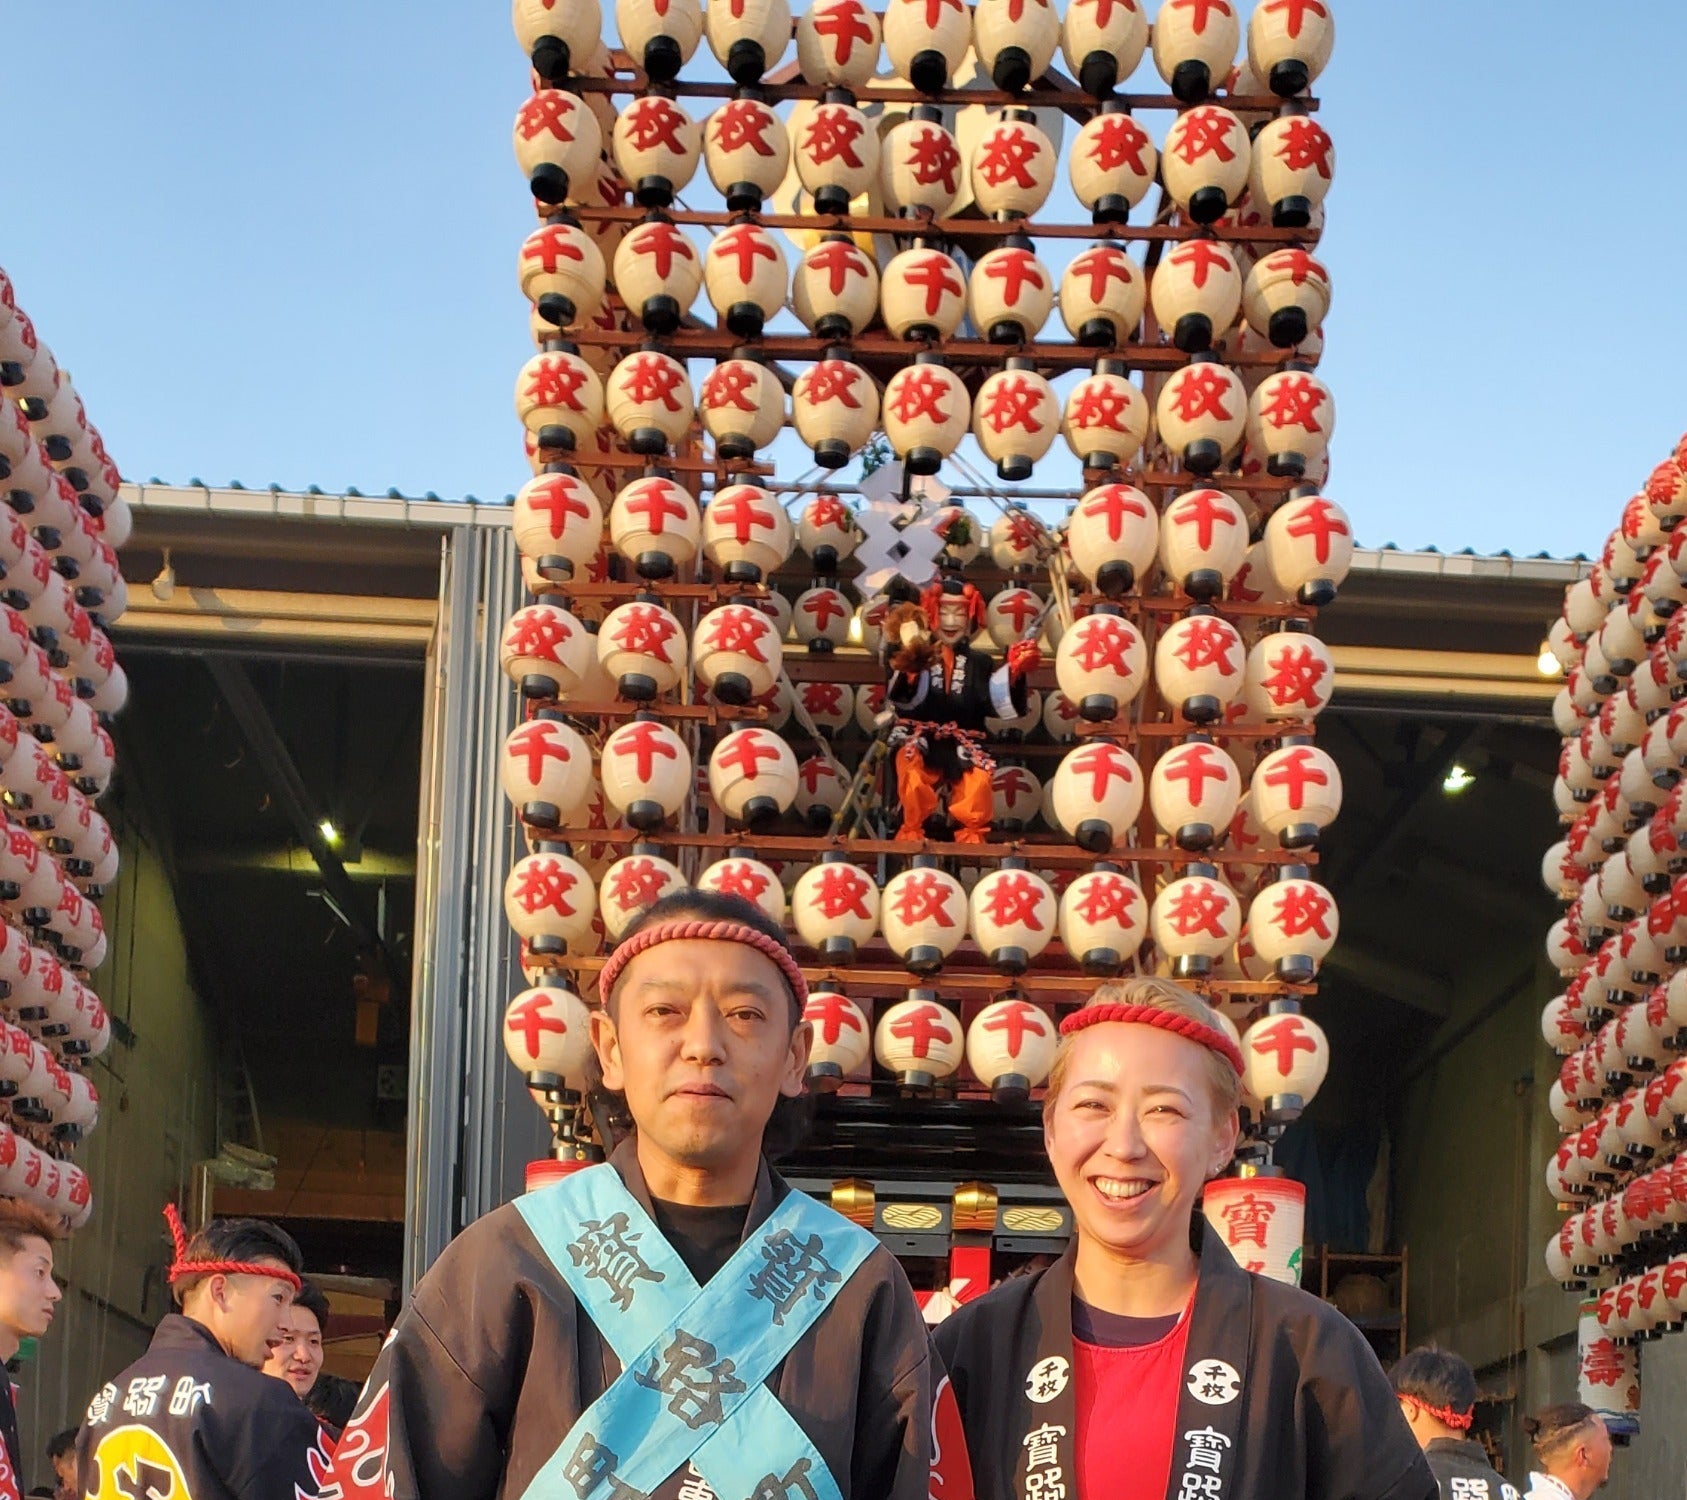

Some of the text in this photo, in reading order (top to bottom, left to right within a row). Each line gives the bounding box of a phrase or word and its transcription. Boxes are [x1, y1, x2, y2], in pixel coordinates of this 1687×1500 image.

[814, 0, 873, 66] 千
[514, 89, 575, 142] 枚
[626, 97, 686, 155] 枚
[712, 100, 774, 156] 枚
[802, 108, 862, 166] 枚
[1175, 105, 1235, 164] 枚
[906, 129, 959, 193] 枚
[979, 128, 1039, 188] 枚
[1088, 117, 1147, 175] 枚
[1277, 116, 1333, 179] 枚
[524, 226, 583, 273] 千
[634, 223, 690, 279] 千
[716, 224, 776, 284] 千
[809, 242, 864, 295] 千
[1074, 248, 1129, 303] 千
[1172, 239, 1230, 288] 千
[1267, 249, 1328, 286] 千
[905, 256, 961, 316] 千
[986, 251, 1043, 307] 千
[524, 359, 587, 412] 枚
[625, 357, 682, 412] 枚
[703, 361, 760, 412] 枚
[803, 360, 863, 409] 枚
[892, 371, 950, 424] 枚
[984, 379, 1043, 433] 枚
[1070, 384, 1131, 433] 枚
[1173, 367, 1231, 422] 枚
[1261, 377, 1325, 432] 枚
[529, 477, 590, 540] 千
[627, 480, 687, 535] 千
[714, 489, 774, 545] 千
[1085, 483, 1146, 542] 千
[1174, 491, 1236, 551] 千
[1288, 500, 1347, 564] 千
[509, 613, 571, 664] 枚
[614, 607, 676, 663] 枚
[708, 609, 768, 663] 枚
[803, 590, 845, 632] 千
[996, 590, 1039, 633] 千
[1075, 619, 1134, 677] 枚
[1178, 619, 1235, 676] 枚
[1263, 648, 1325, 708] 枚
[510, 723, 569, 784] 千
[615, 723, 676, 782] 千
[718, 731, 779, 780] 千
[1070, 744, 1132, 801] 千
[1166, 746, 1227, 806] 千
[1265, 750, 1327, 809] 千
[516, 862, 577, 916] 枚
[810, 866, 872, 920] 枚
[895, 876, 953, 927] 枚
[986, 876, 1043, 931] 枚
[1077, 877, 1136, 929] 枚
[1167, 883, 1229, 938] 枚
[1270, 884, 1331, 940] 枚
[507, 993, 567, 1059] 千
[804, 995, 862, 1046] 千
[892, 1007, 952, 1058] 千
[986, 1001, 1045, 1057] 千
[1254, 1019, 1315, 1075] 千
